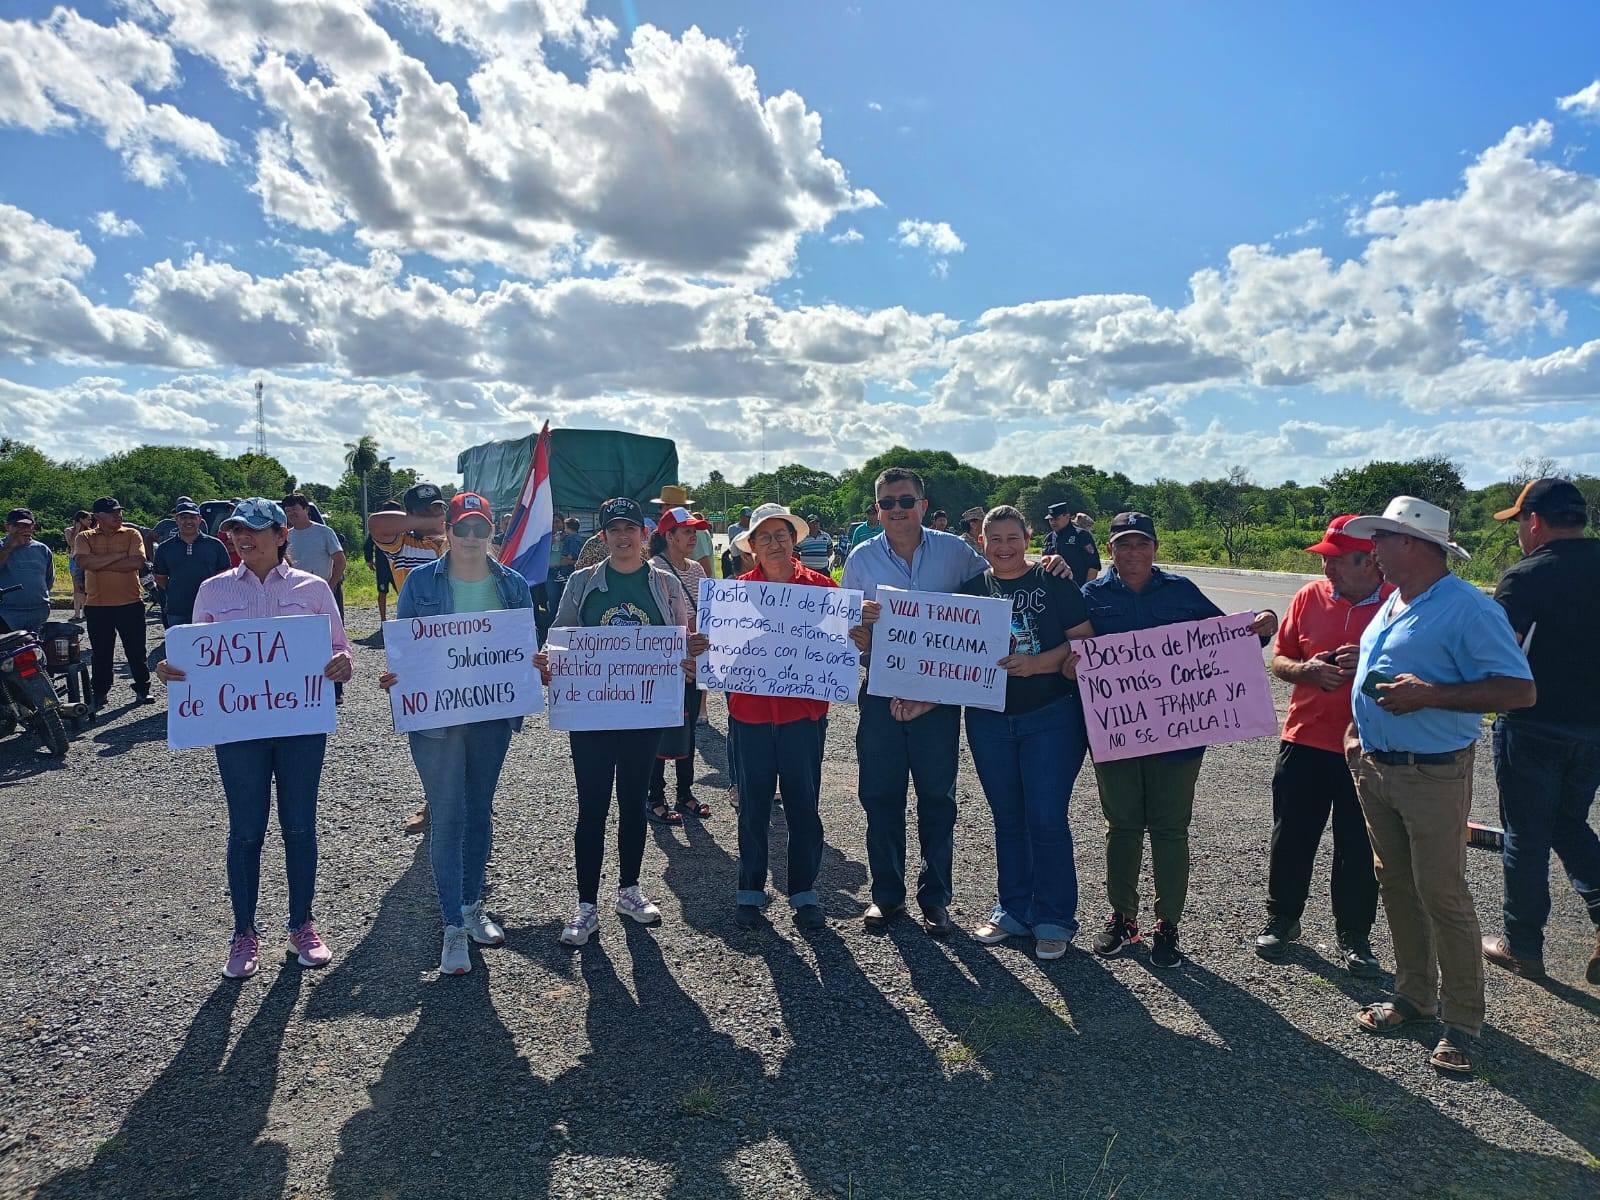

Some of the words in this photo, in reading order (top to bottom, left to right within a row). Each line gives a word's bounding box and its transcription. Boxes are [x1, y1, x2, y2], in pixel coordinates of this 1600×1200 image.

[606, 500, 634, 513] LACOSTE
[699, 579, 749, 602] Basta
[797, 592, 816, 613] de
[888, 598, 920, 618] VILLA
[926, 603, 981, 625] FRANCA
[411, 617, 492, 640] Queremos
[790, 621, 847, 645] estamos
[887, 628, 917, 645] SOLO
[922, 631, 988, 655] RECLAMA
[191, 630, 289, 667] BASTA
[447, 646, 525, 669] Soluciones
[566, 630, 631, 659] Exigimos
[704, 640, 767, 657] ansados
[774, 646, 798, 657] con
[804, 645, 824, 662] los
[1081, 632, 1156, 672] Basta
[1161, 634, 1184, 657] de
[1186, 621, 1257, 653] Mentiras
[550, 655, 601, 677] eléctrica
[608, 659, 678, 684] permanente
[700, 663, 716, 674] de
[777, 663, 799, 681] día
[817, 671, 838, 686] día
[886, 654, 906, 671] SU
[552, 688, 561, 705] y
[565, 682, 581, 702] de
[1115, 669, 1162, 694] más
[178, 684, 204, 718] de
[401, 691, 428, 716] NO
[434, 681, 515, 712] APAGONES
[1093, 700, 1148, 731] VILLA
[1154, 687, 1218, 717] FRANCA
[1225, 681, 1248, 703] YA
[1108, 732, 1126, 750] NO
[1135, 728, 1159, 745] SE
